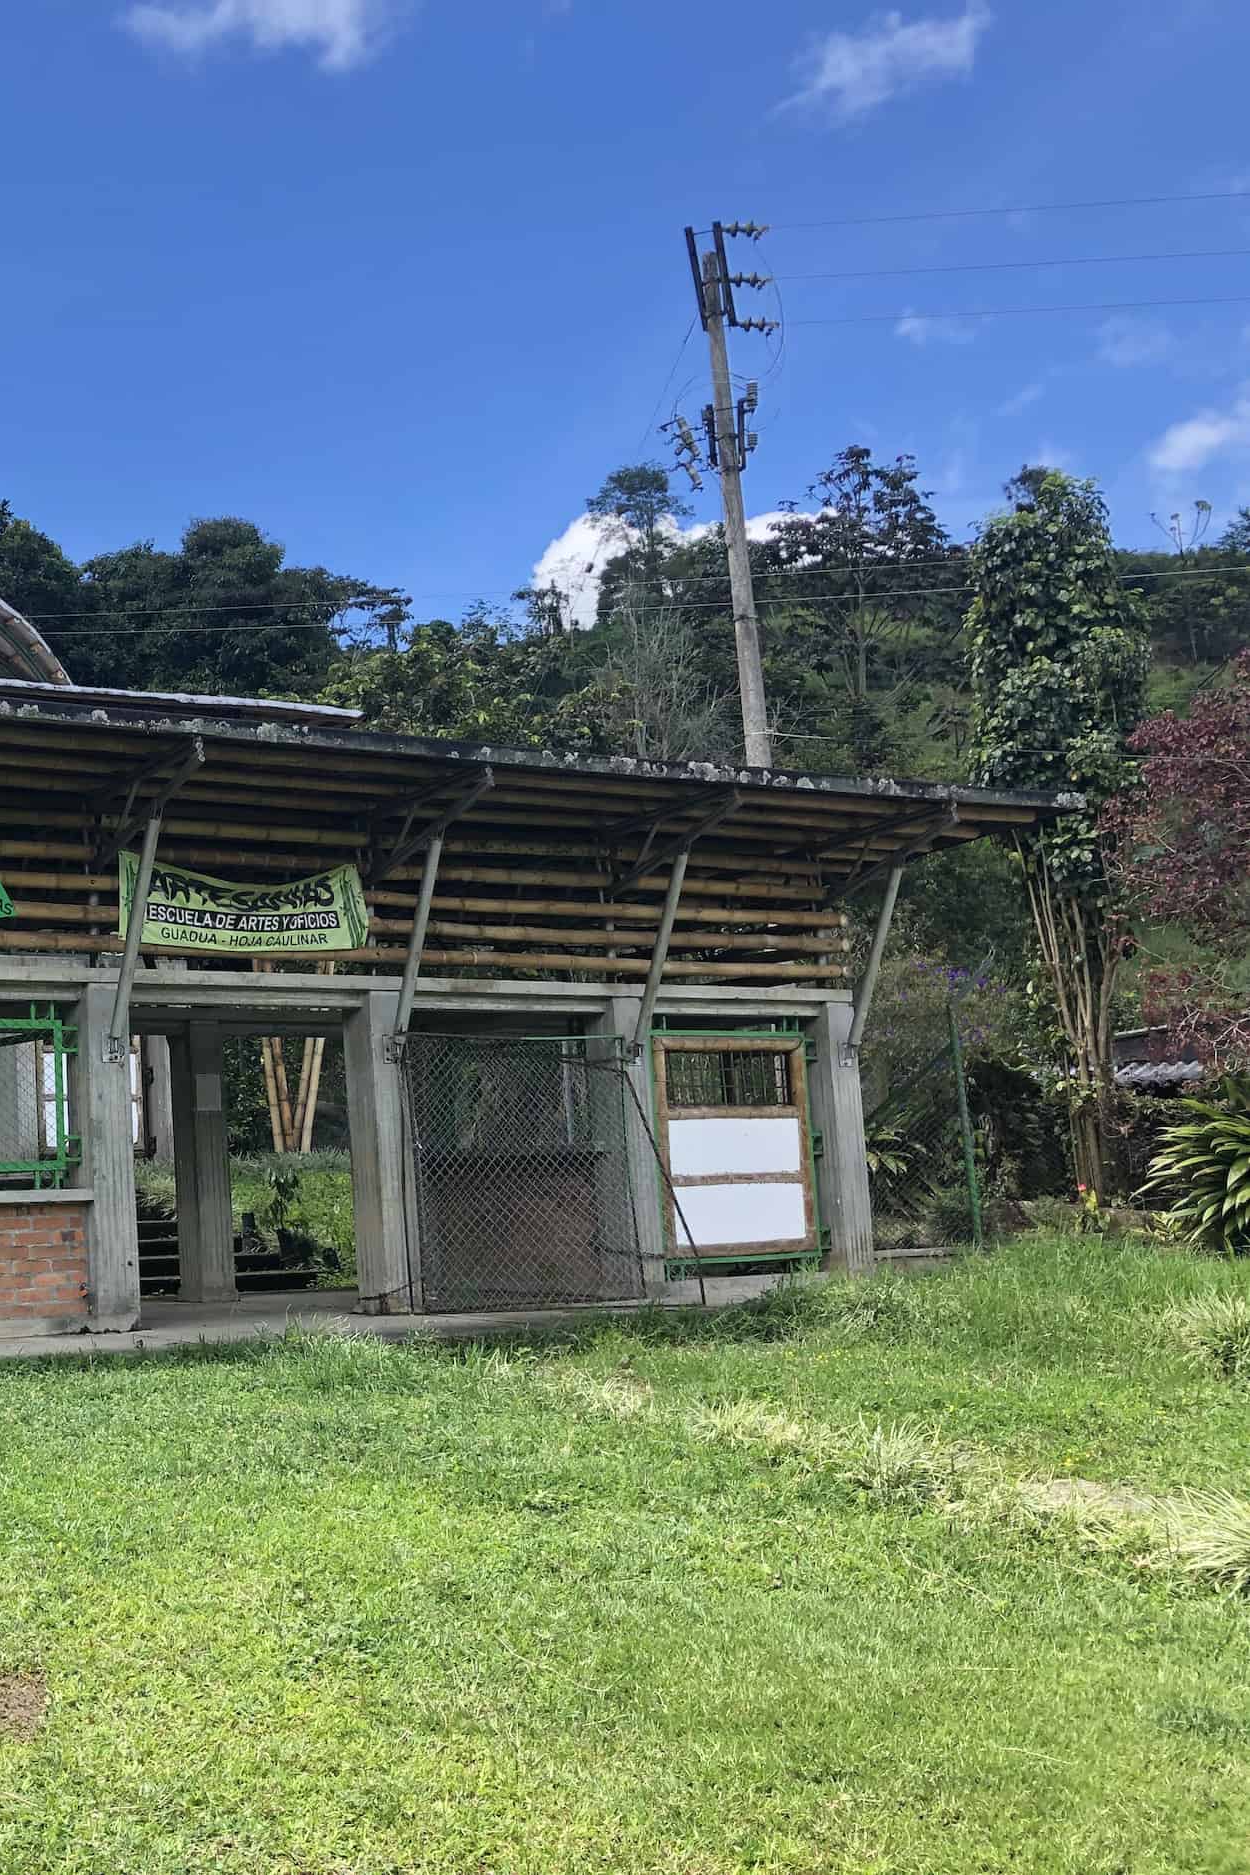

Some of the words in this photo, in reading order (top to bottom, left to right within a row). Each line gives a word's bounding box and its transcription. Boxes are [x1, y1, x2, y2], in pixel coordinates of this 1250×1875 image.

[149, 904, 213, 928] ESCUELA
[215, 914, 237, 929] DE
[237, 915, 279, 931] ARTES
[283, 915, 290, 930] Y
[290, 912, 337, 930] OFICIOS
[161, 927, 217, 944] GUADUA
[229, 935, 262, 947] HOJA
[266, 933, 328, 947] CAULINAR
